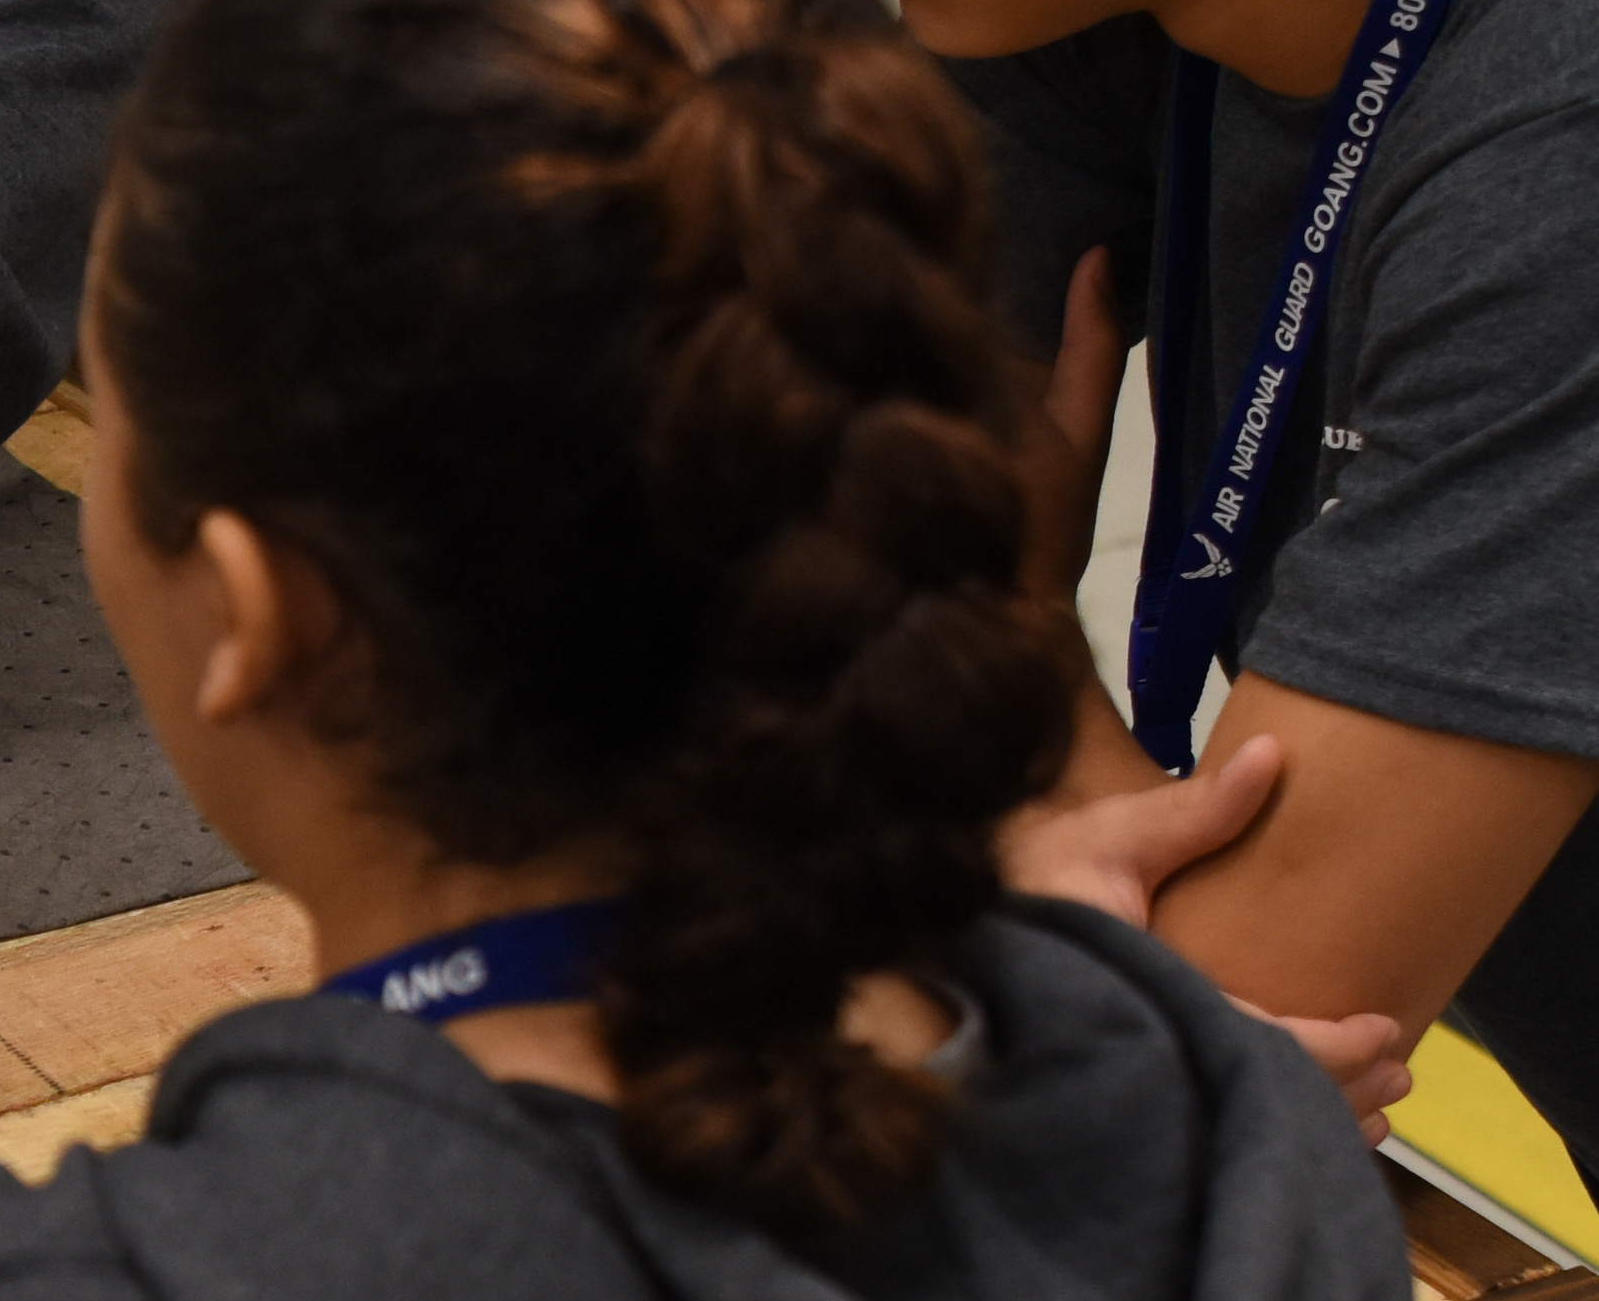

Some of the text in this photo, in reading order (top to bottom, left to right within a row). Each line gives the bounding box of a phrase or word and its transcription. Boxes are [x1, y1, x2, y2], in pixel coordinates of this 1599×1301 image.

[1211, 486, 1245, 534] AIR
[1228, 364, 1285, 481] NATIONAL
[1274, 262, 1315, 352] GUARD
[1304, 61, 1397, 253] GOANG.COM
